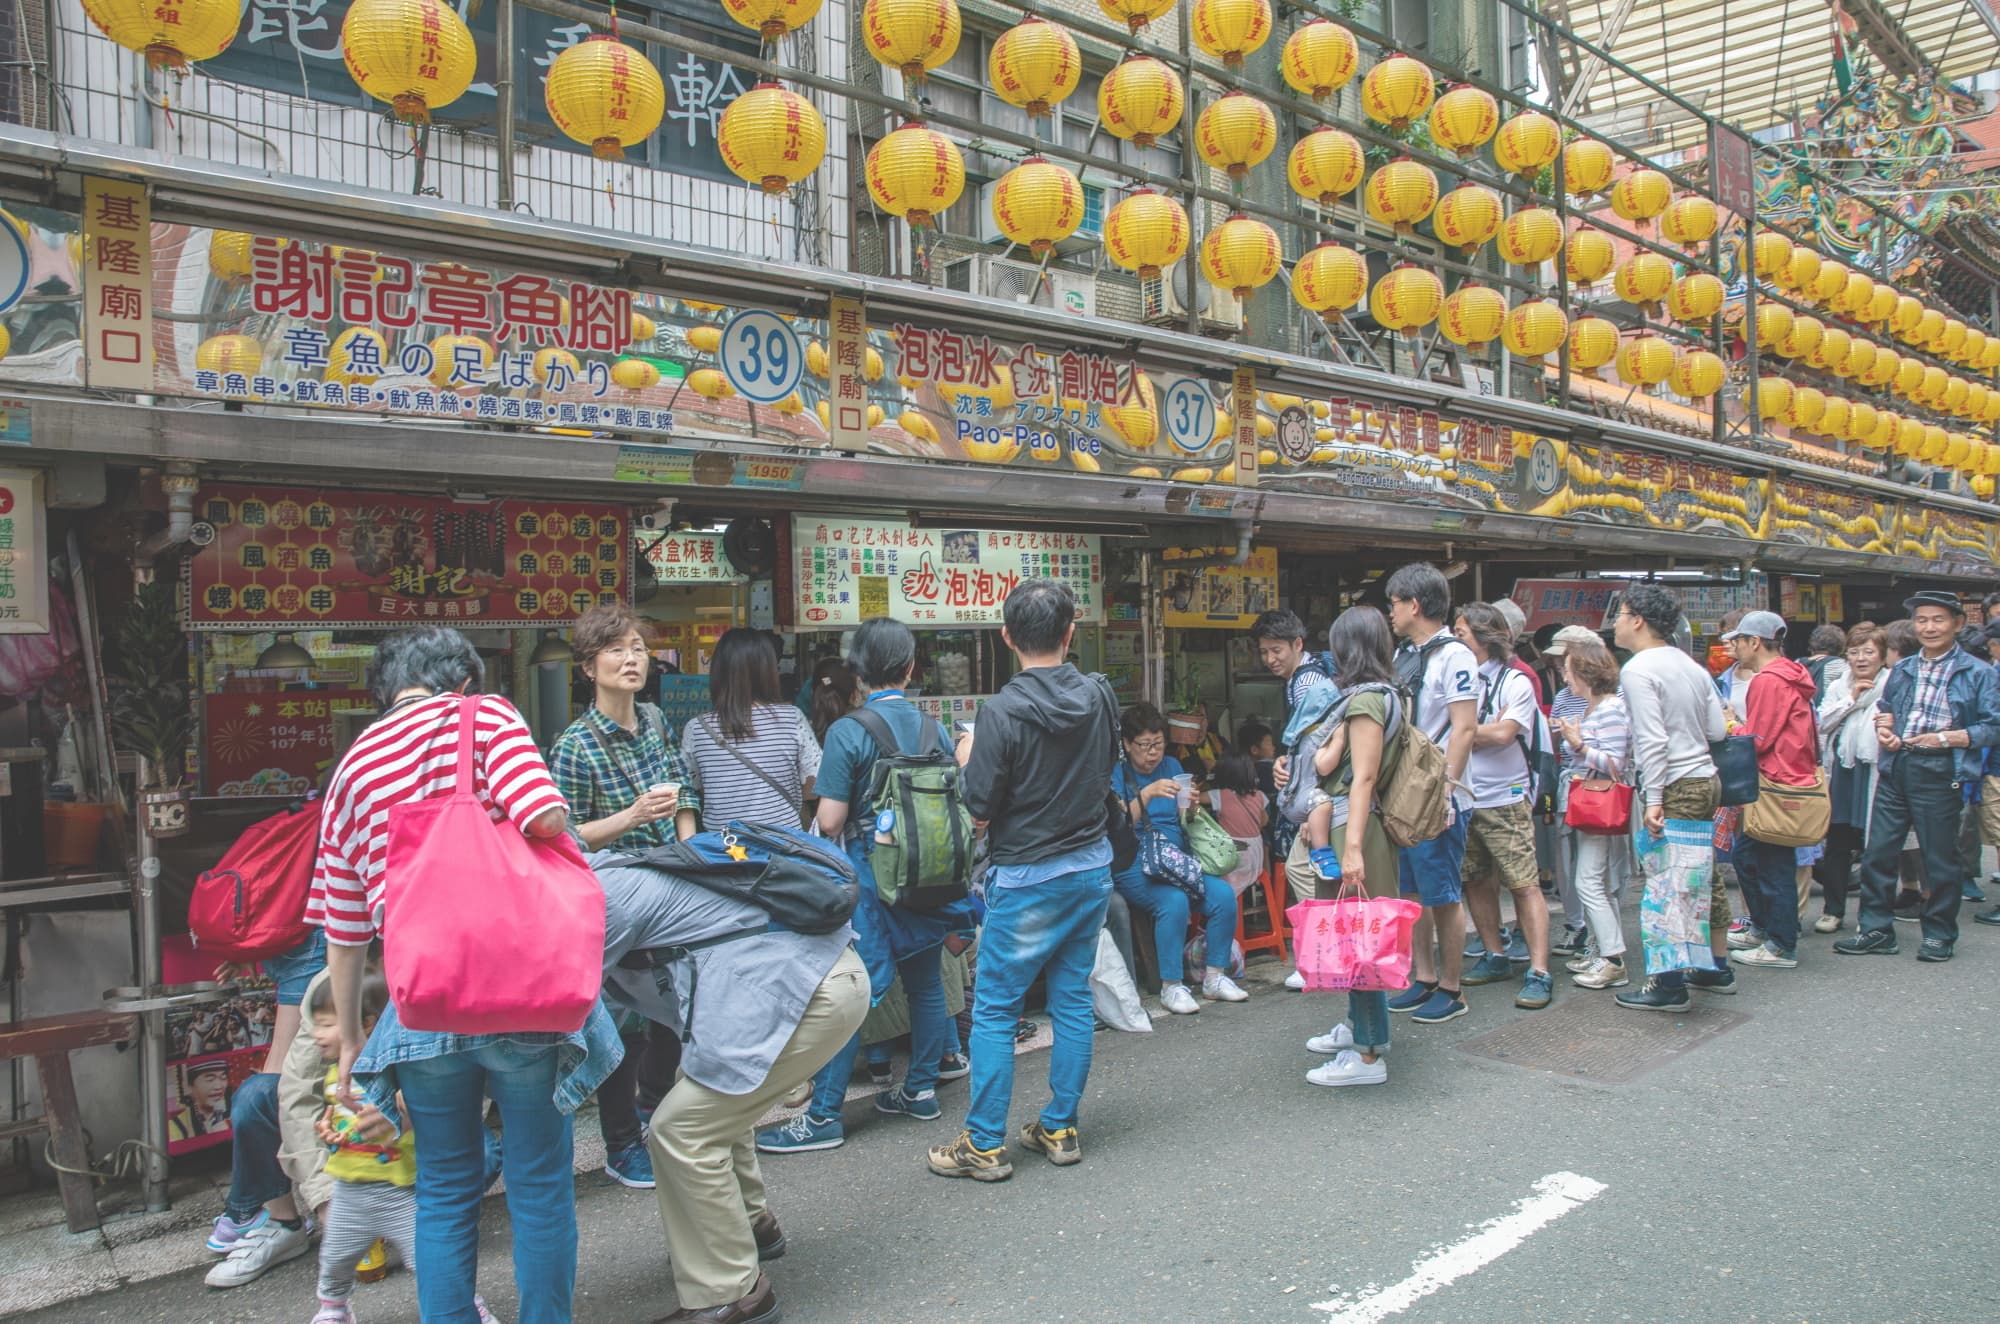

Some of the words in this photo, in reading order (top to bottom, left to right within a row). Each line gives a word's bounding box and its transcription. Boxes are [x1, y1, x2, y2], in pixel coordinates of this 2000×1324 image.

[95, 191, 142, 364] 基隆廟口
[252, 236, 633, 356] 謝記章魚腳
[283, 327, 610, 397] 章魚の足ばかり
[739, 324, 789, 386] 39
[836, 307, 863, 432] 基隆廟口
[894, 322, 1001, 390] 泡泡冰
[1027, 366, 1051, 395] 沈
[1059, 350, 1147, 409] 創始人
[956, 393, 993, 417] 沈家
[1175, 390, 1205, 438] 37
[957, 419, 1056, 450] Pao-Pao
[1070, 432, 1100, 454] Ice
[1535, 446, 1556, 483] 35-1
[276, 502, 300, 612] 燒酒螺
[308, 505, 333, 612] 魷魚串
[815, 524, 934, 548] 廟口泡泡冰創始人
[518, 515, 539, 612] 章魚串
[826, 547, 838, 605] 巧克力牛乳
[838, 548, 850, 604] 情人果
[887, 549, 898, 576] 花生
[904, 561, 940, 600] 沈
[1455, 669, 1471, 693] 2
[270, 725, 297, 736] 104
[299, 729, 316, 743] 年
[270, 738, 297, 750] 107
[148, 803, 185, 827] HC
